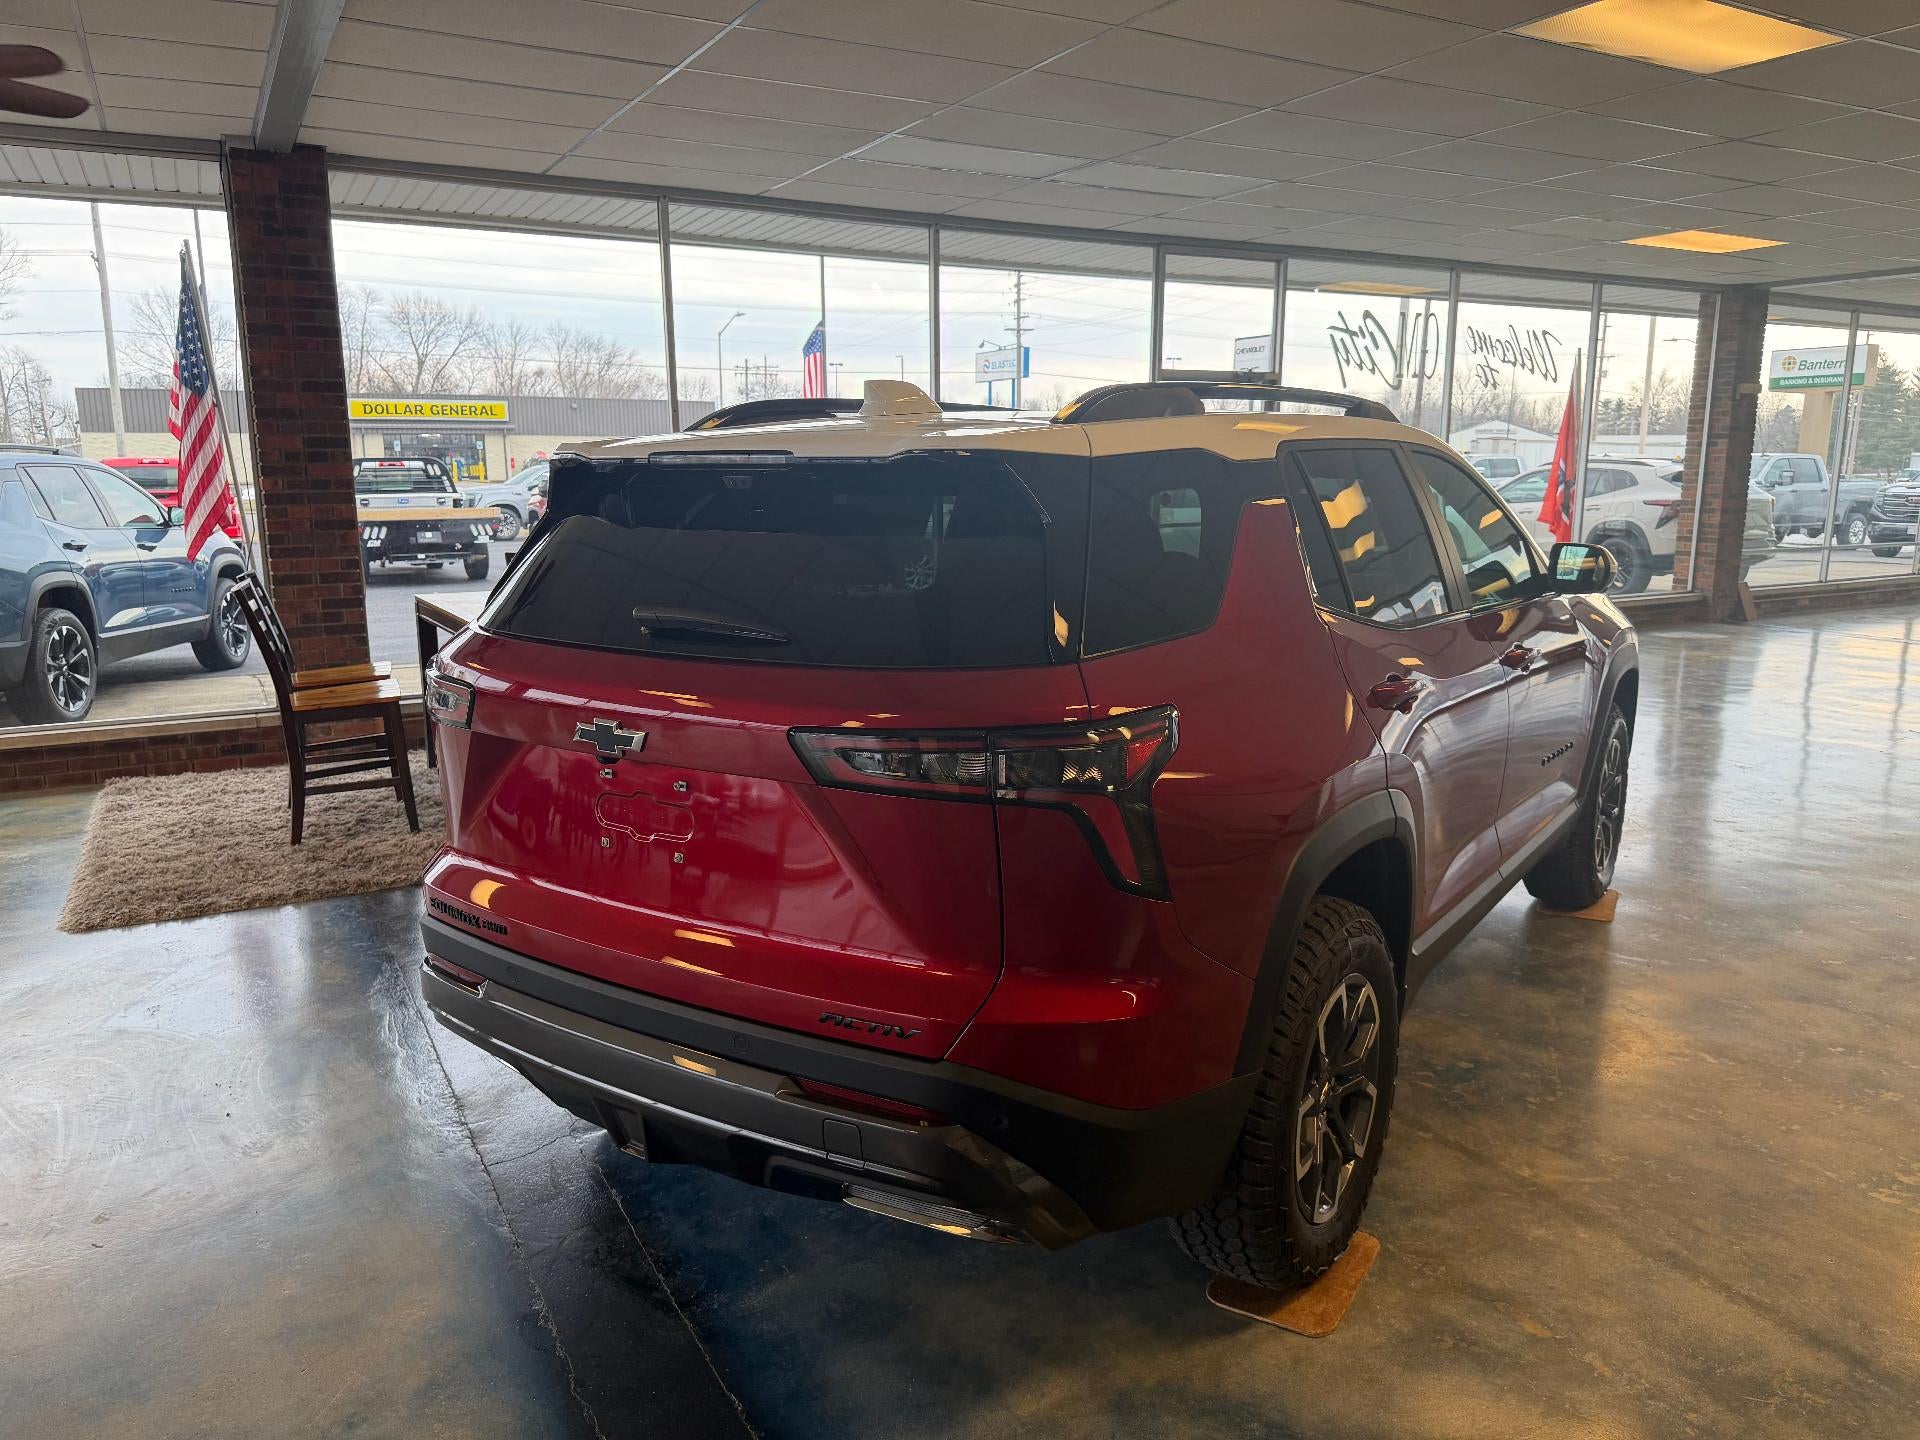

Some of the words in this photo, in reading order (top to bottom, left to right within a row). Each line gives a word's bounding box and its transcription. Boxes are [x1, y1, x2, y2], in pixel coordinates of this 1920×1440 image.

[1235, 345, 1266, 355] CHEVROLET
[1798, 359, 1847, 371] Banterr
[1779, 378, 1808, 386] BANKING
[361, 403, 425, 415] DOLLAR
[429, 404, 498, 416] GENERAL
[819, 1011, 922, 1039] ACTIV
